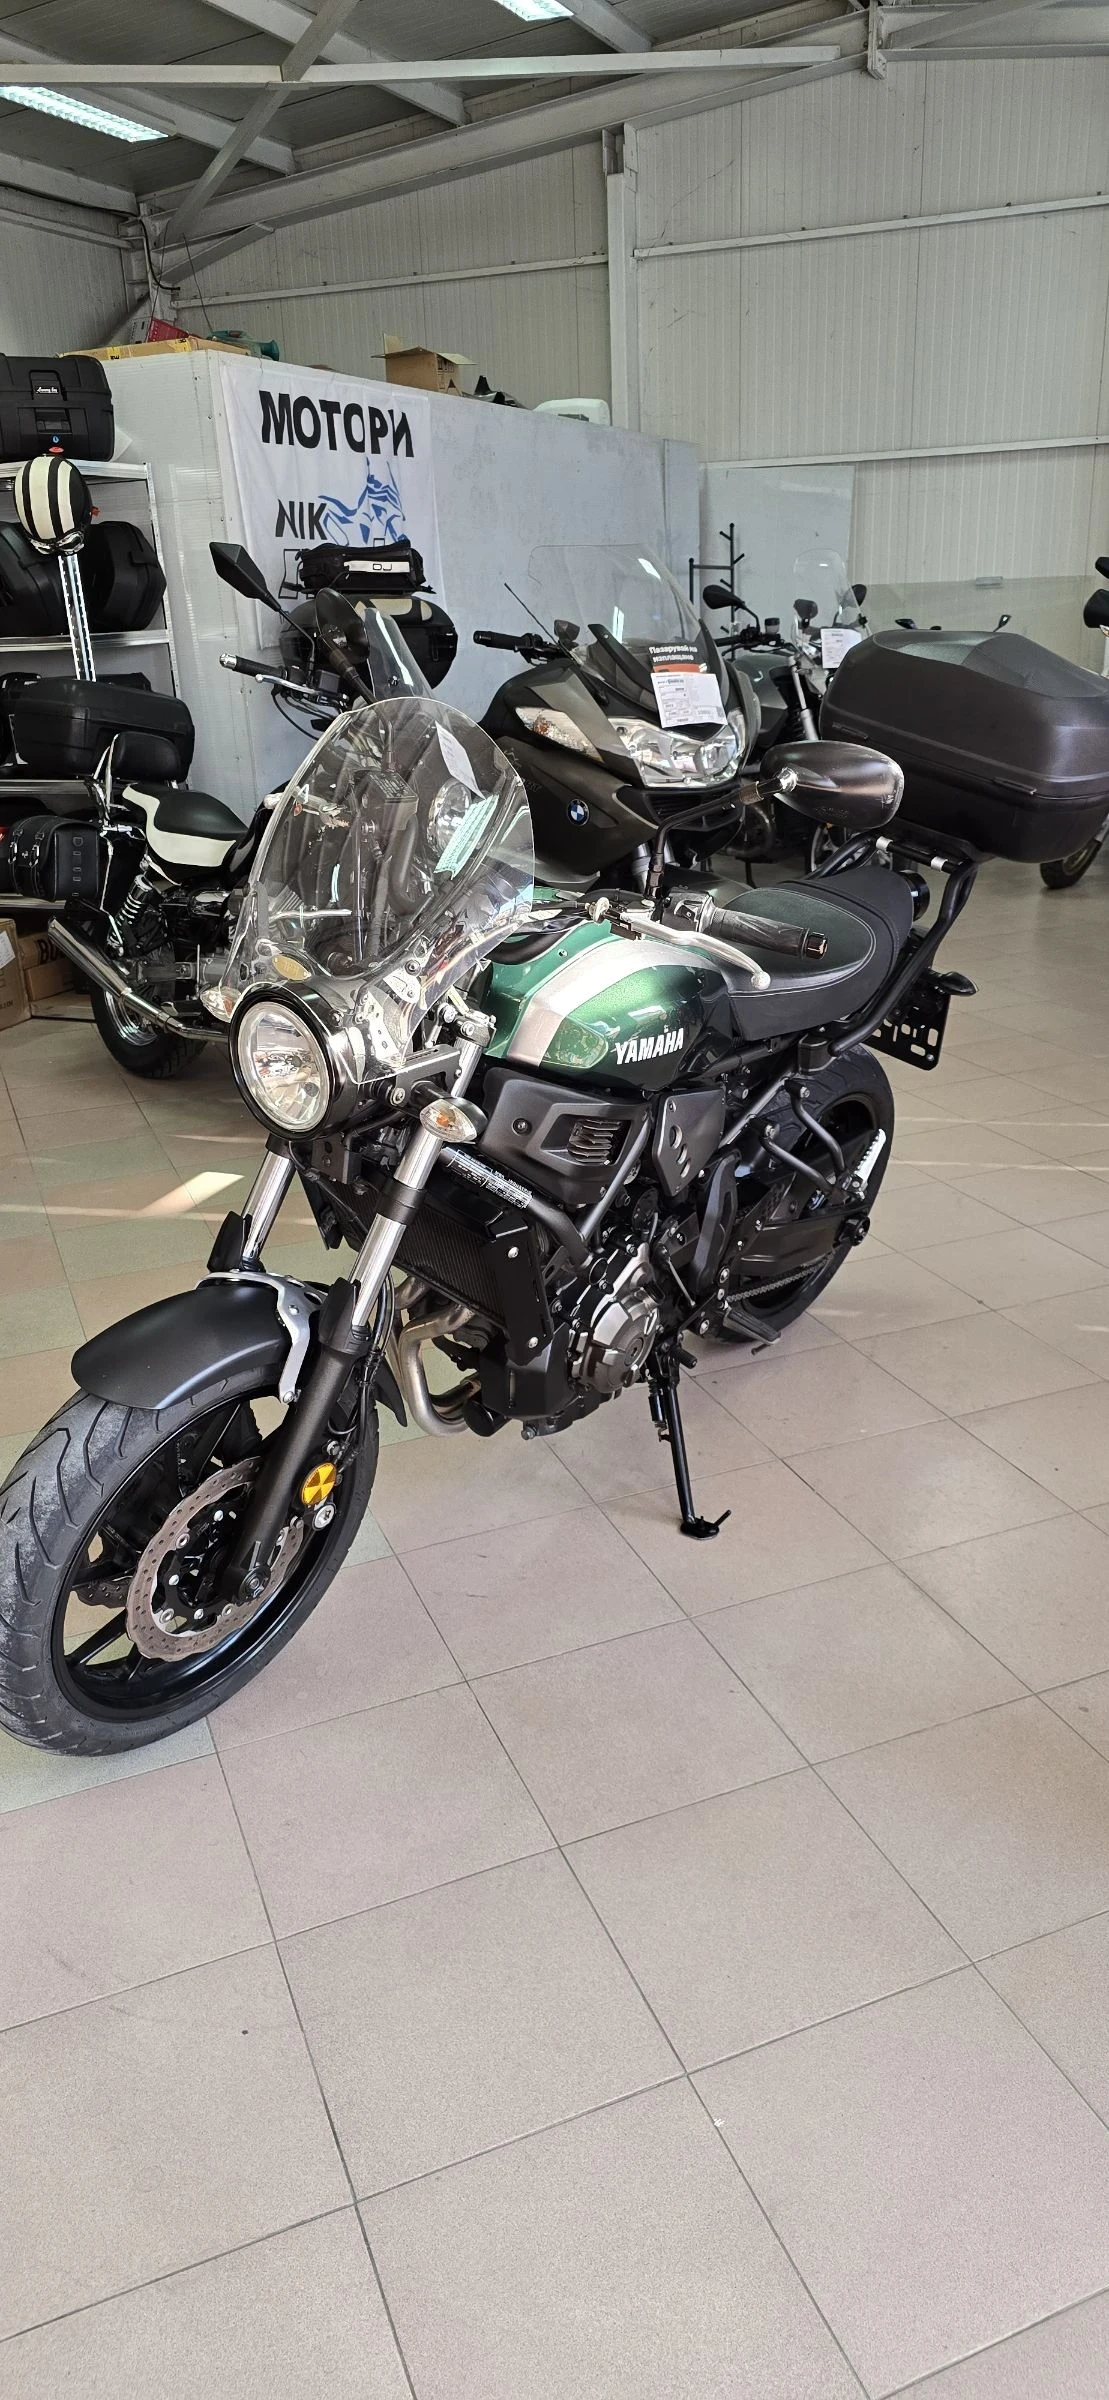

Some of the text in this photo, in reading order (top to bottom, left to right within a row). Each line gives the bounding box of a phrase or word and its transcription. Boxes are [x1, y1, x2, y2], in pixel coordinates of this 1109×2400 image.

[259, 390, 414, 457] МОТОРИ
[275, 499, 327, 540] NIK
[615, 1028, 684, 1065] YAMAHA
